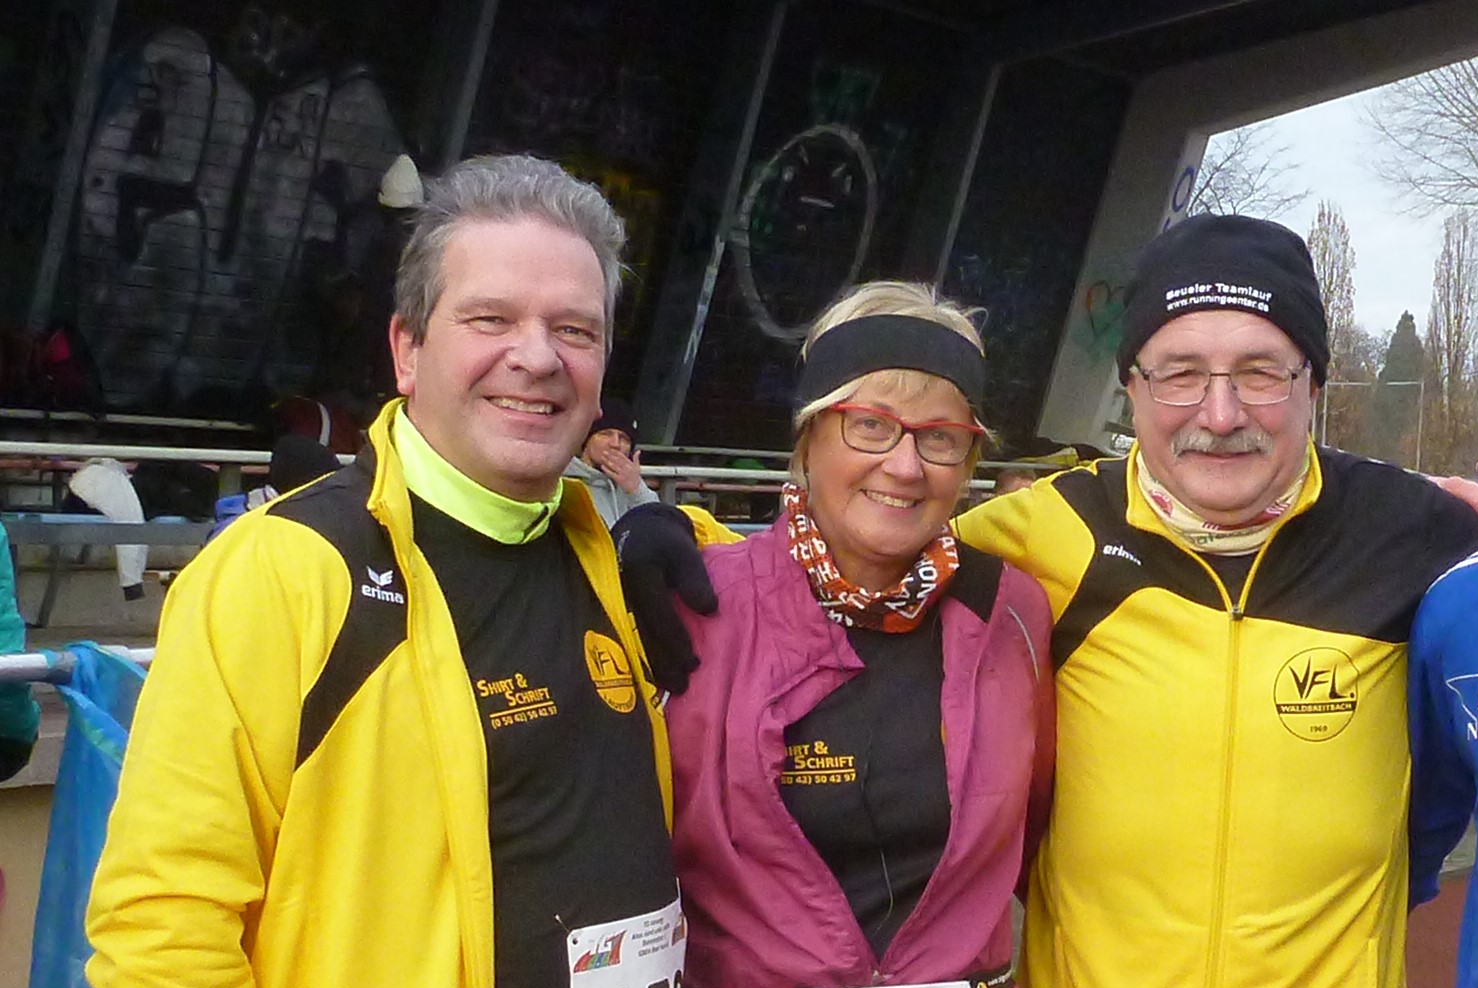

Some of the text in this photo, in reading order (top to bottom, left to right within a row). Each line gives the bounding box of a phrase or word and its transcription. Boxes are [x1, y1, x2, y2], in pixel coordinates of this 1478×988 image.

[1214, 283, 1272, 301] Teamlauf
[361, 584, 405, 605] erima
[514, 673, 528, 688] &
[504, 687, 550, 707] SCHRIFT
[1280, 703, 1352, 713] WALDBREITBACH
[814, 740, 829, 755] &
[794, 755, 855, 770] SCHRIFT
[843, 772, 857, 782] 97
